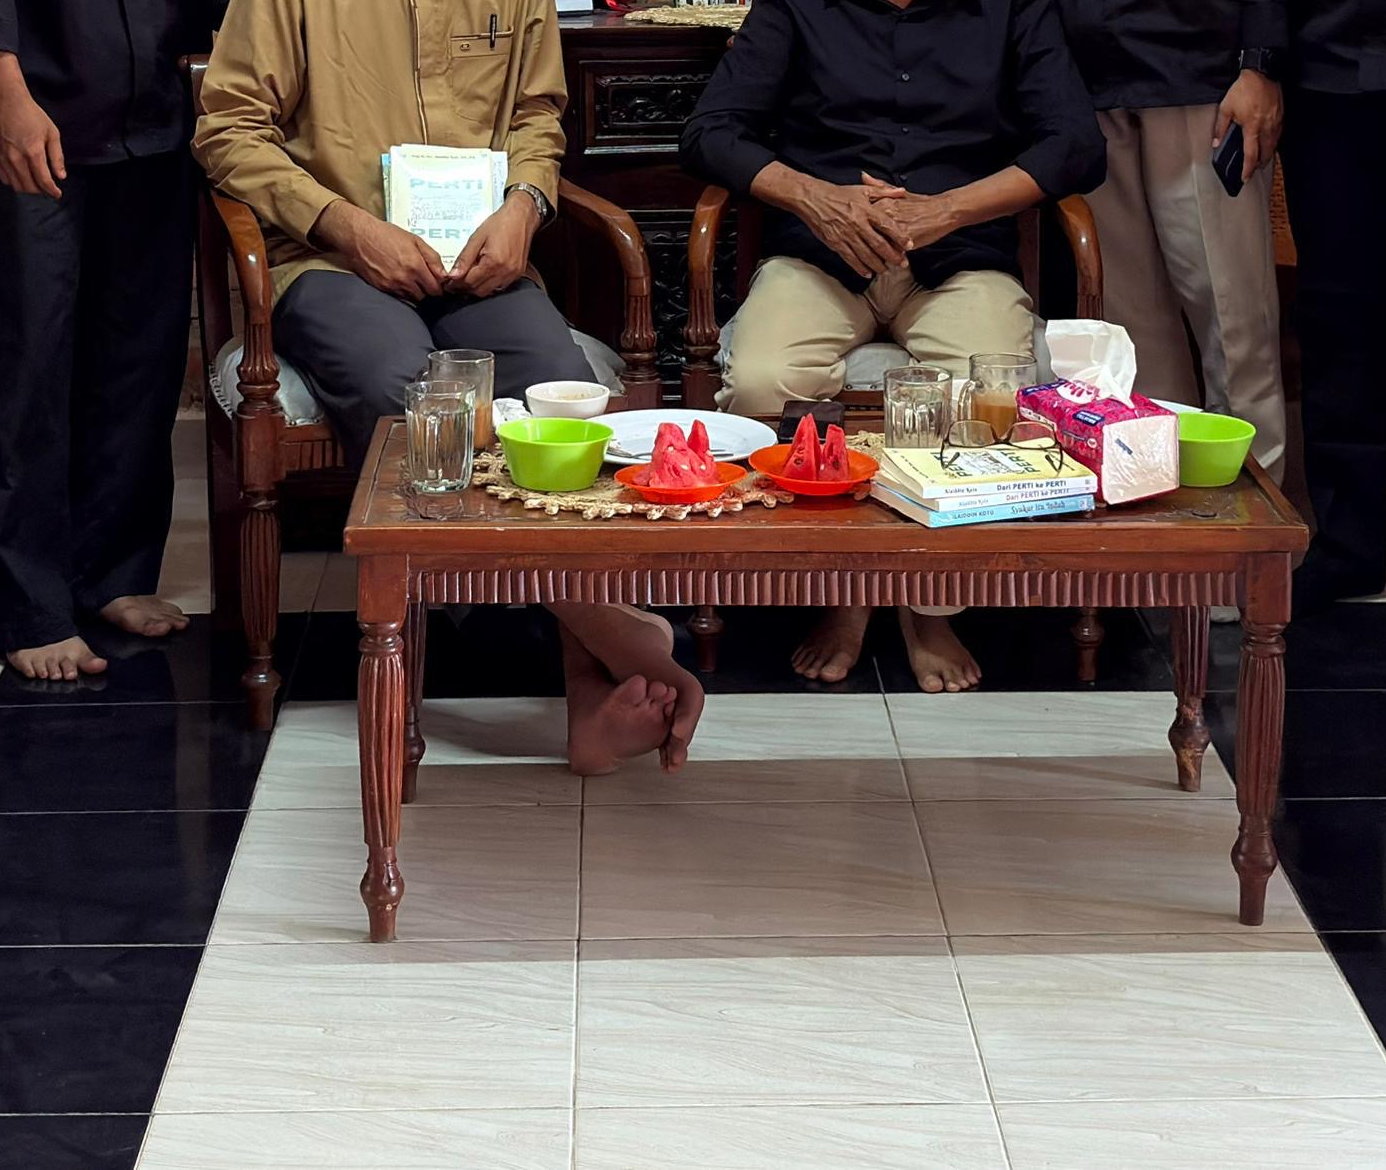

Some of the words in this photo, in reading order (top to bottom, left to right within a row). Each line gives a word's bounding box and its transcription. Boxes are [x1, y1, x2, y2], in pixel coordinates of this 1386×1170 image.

[409, 178, 483, 190] PERTI
[409, 228, 471, 239] PER
[997, 483, 1011, 491] Dari
[1013, 482, 1034, 490] PERTI
[1035, 481, 1044, 489] ke
[1045, 480, 1067, 488] PERTI
[1006, 493, 1019, 501] Dari
[1019, 491, 1040, 500] PERTI
[1050, 488, 1070, 496] PERTI
[979, 509, 994, 517] KOTO
